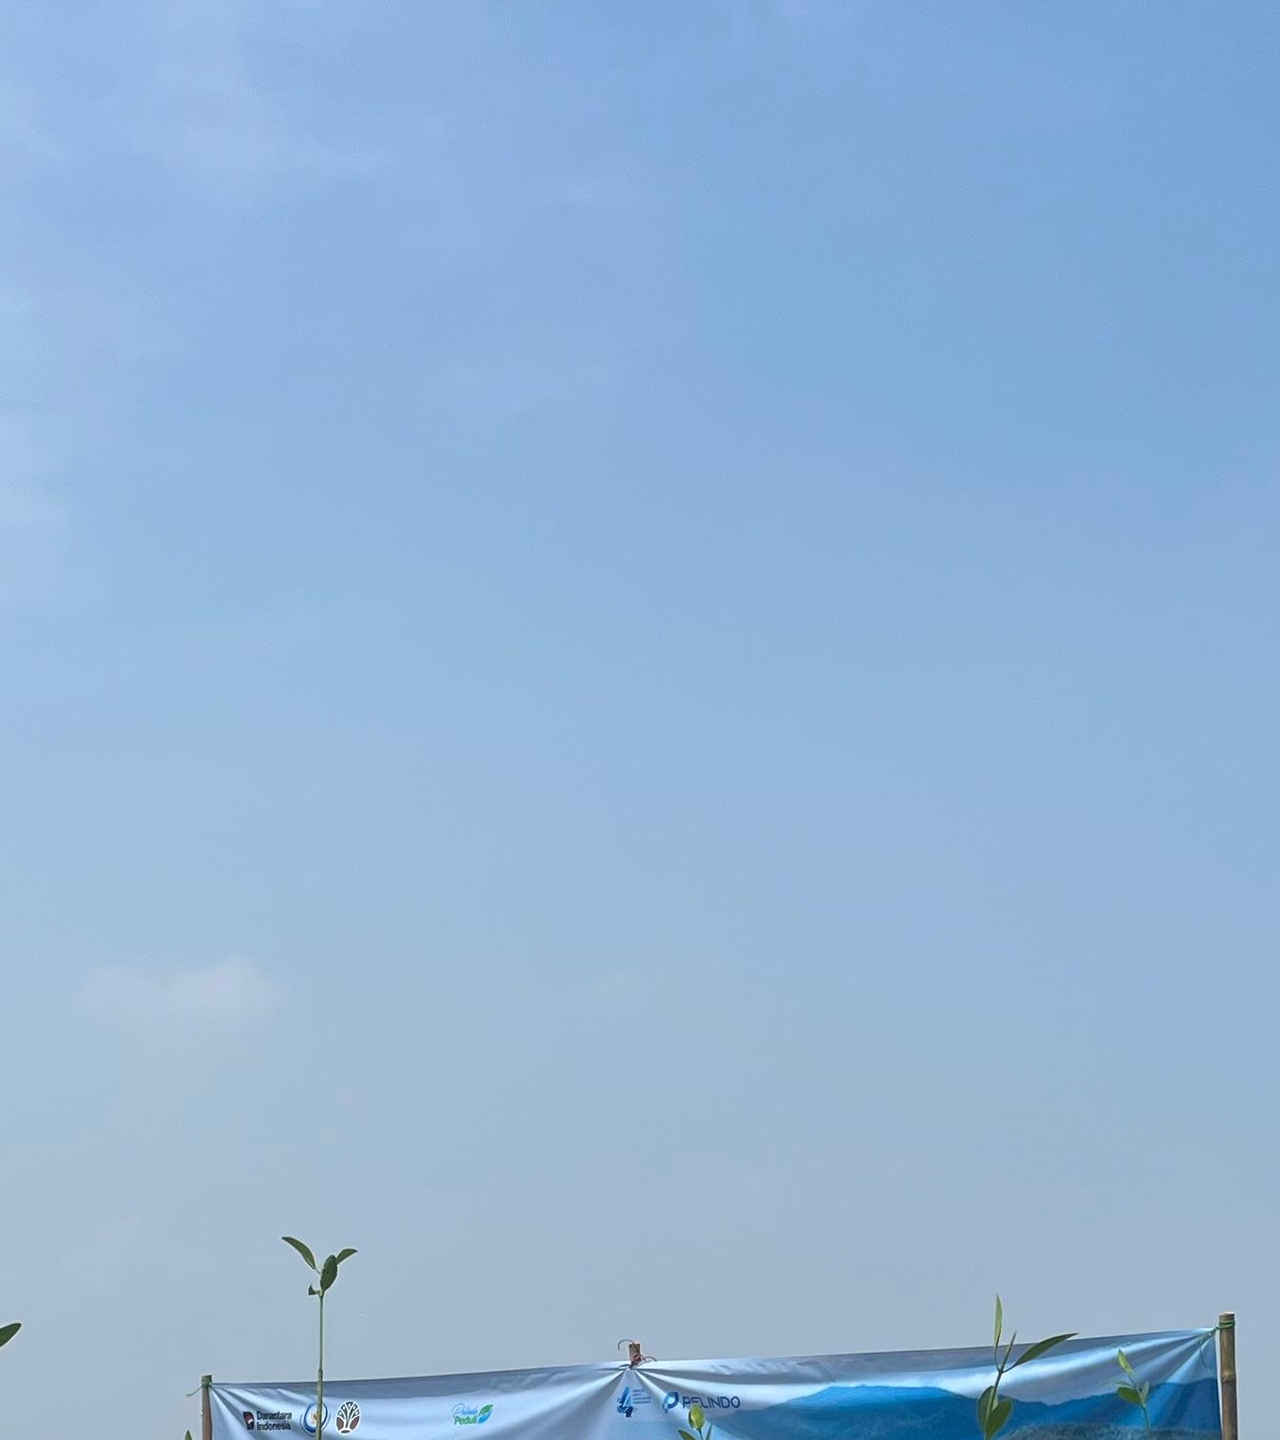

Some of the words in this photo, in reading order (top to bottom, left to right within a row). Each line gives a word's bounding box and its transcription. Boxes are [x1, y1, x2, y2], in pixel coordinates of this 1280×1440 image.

[682, 1396, 741, 1409] PELINDO
[256, 1421, 292, 1430] Indonesia
[454, 1416, 478, 1426] Peduli
